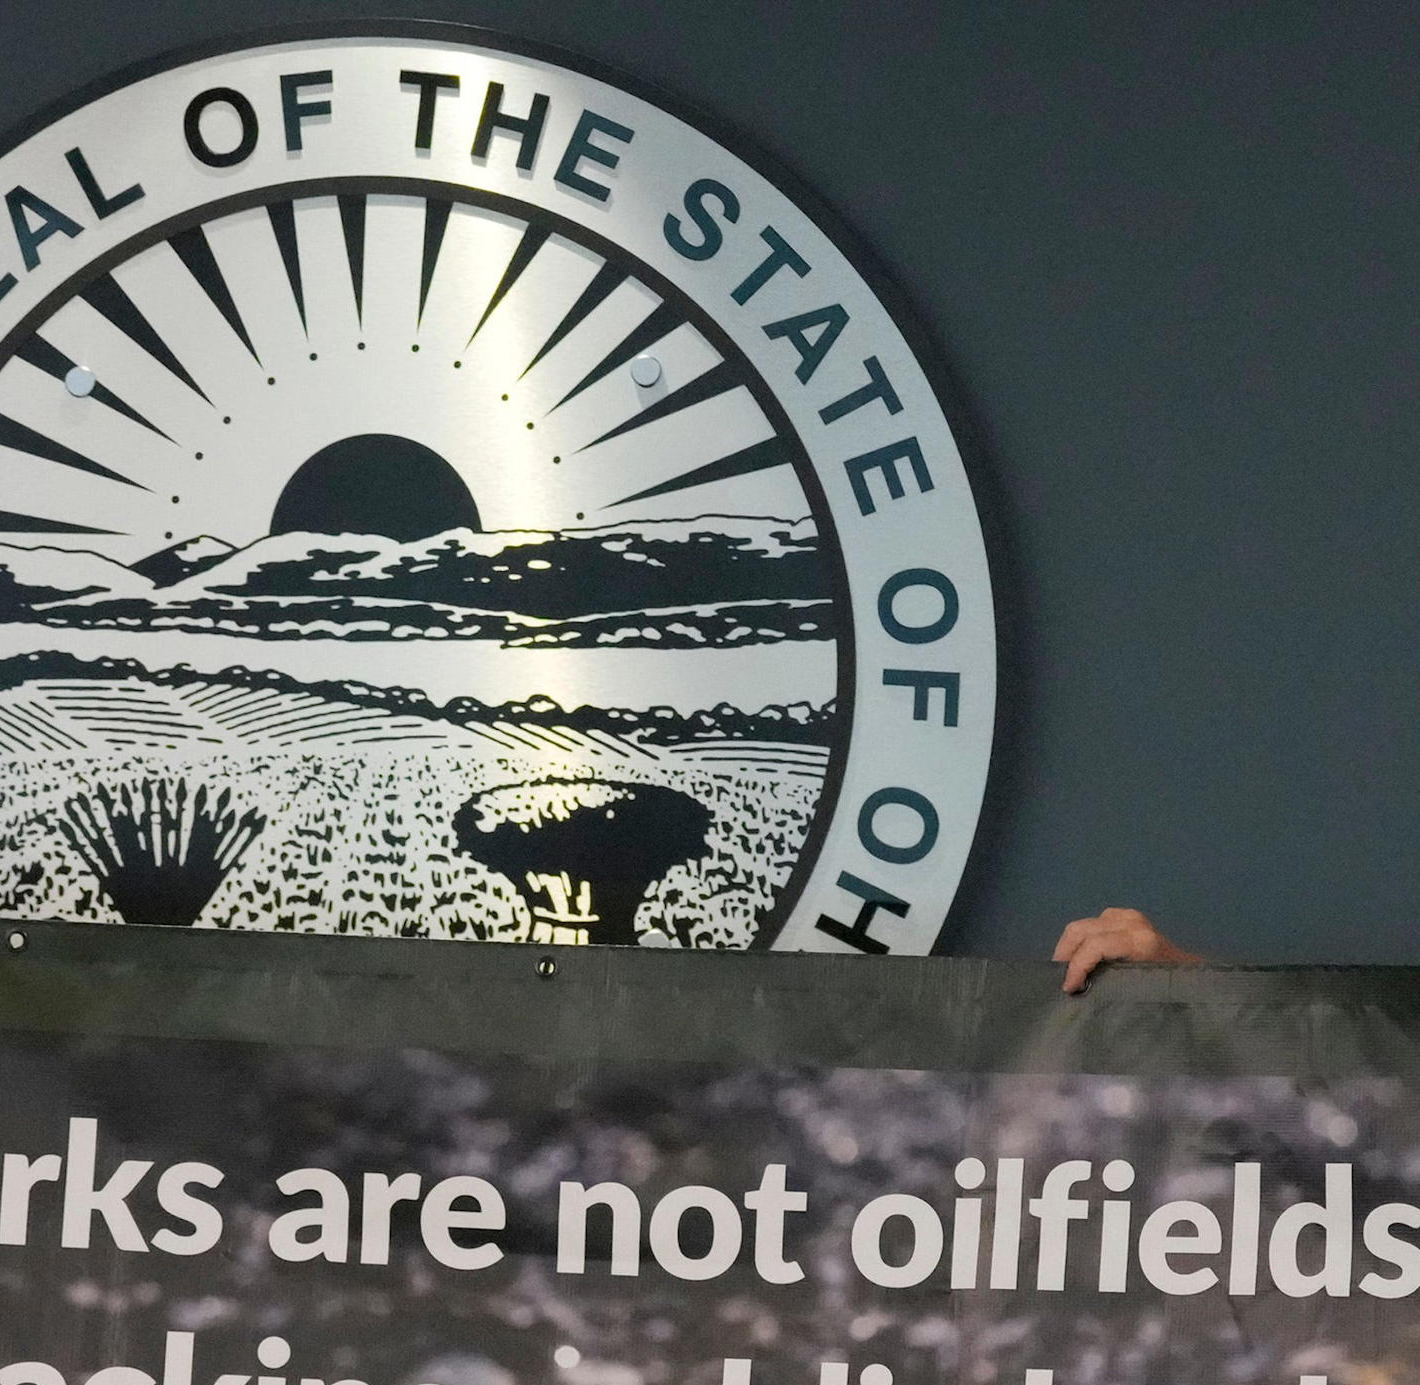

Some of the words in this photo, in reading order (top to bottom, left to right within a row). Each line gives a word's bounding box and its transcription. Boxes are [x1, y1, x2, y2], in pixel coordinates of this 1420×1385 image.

[183, 70, 333, 169] OF
[399, 69, 636, 202] THE
[662, 178, 935, 517] STATE
[877, 567, 961, 728] OF
[814, 786, 940, 955] OH
[268, 1168, 507, 1270] are
[556, 1163, 808, 1284] not
